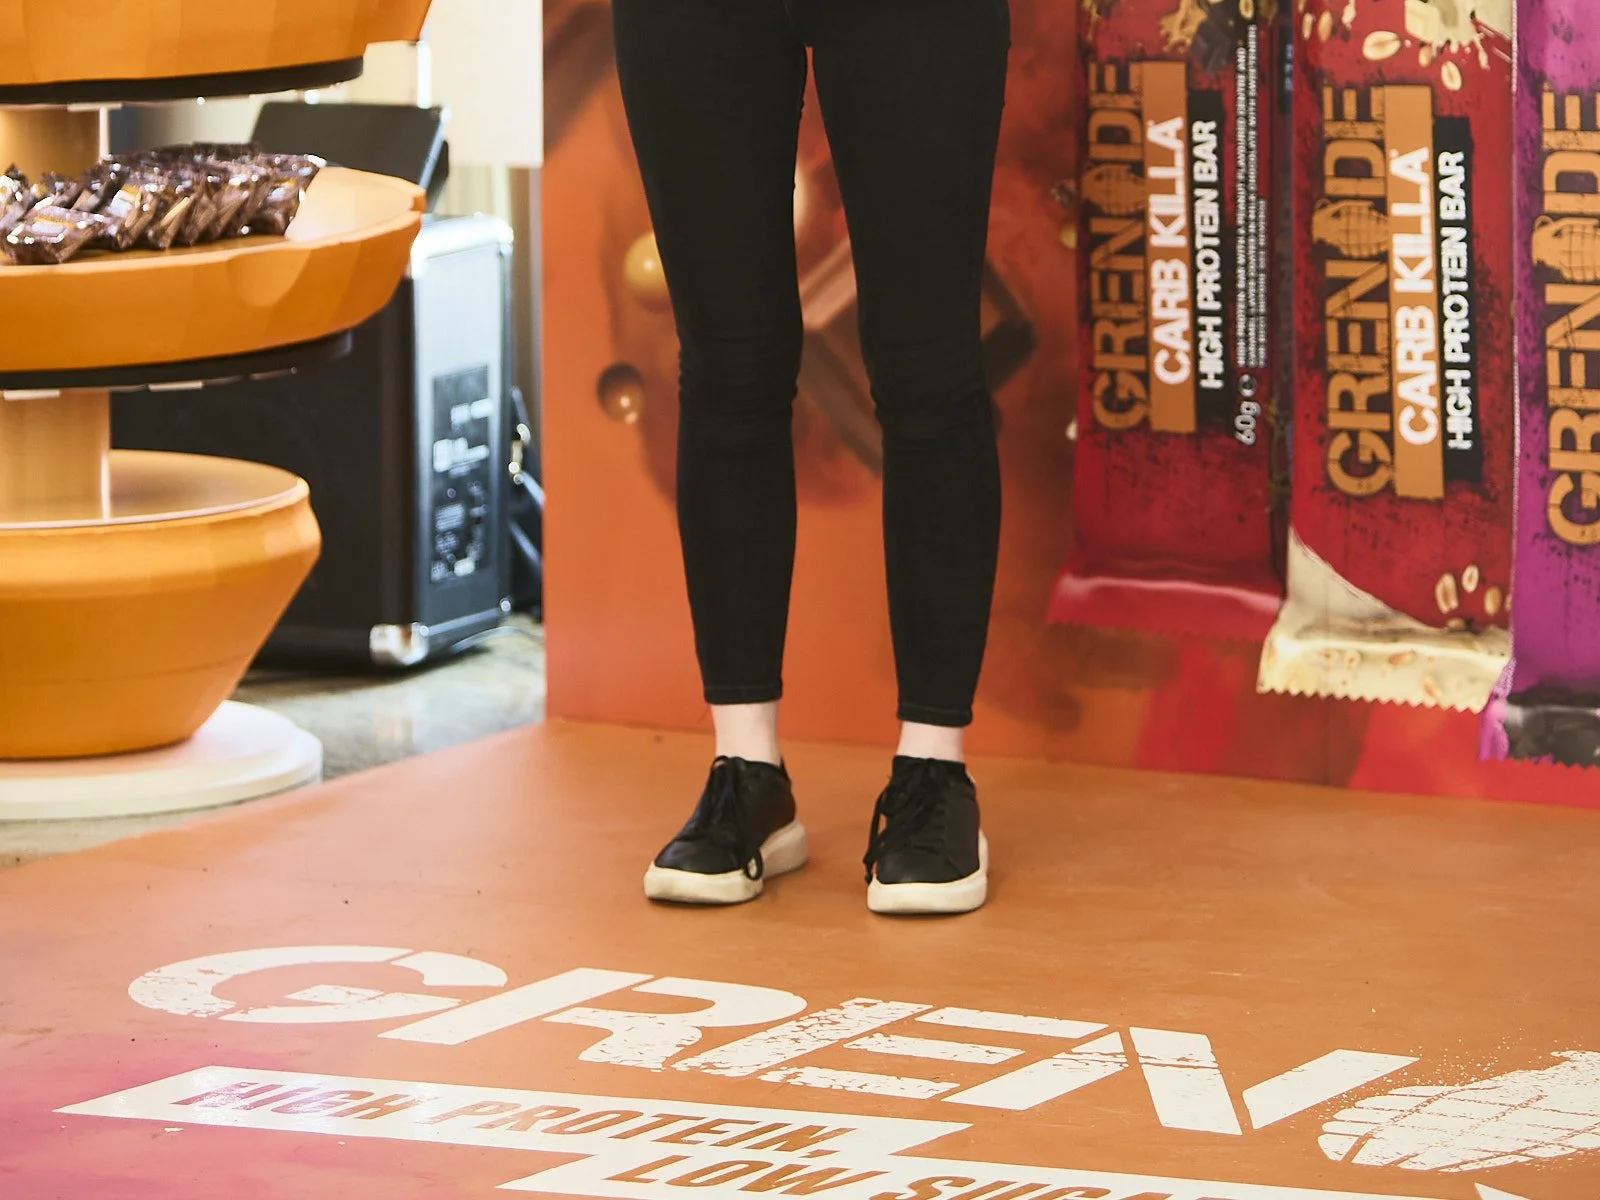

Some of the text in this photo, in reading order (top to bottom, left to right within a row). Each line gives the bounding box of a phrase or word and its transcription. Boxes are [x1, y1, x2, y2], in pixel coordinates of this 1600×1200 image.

[1147, 116, 1191, 385] CARB KILLA
[1192, 120, 1224, 389] HIGH PROTEIN BAR
[1389, 146, 1439, 446] CARB KILLA
[1437, 150, 1473, 451] HIGH PROTEIN BAR
[1234, 401, 1261, 446] 60g
[170, 1081, 857, 1158] HIGH PROTEIN,
[603, 1154, 890, 1196] LOW
